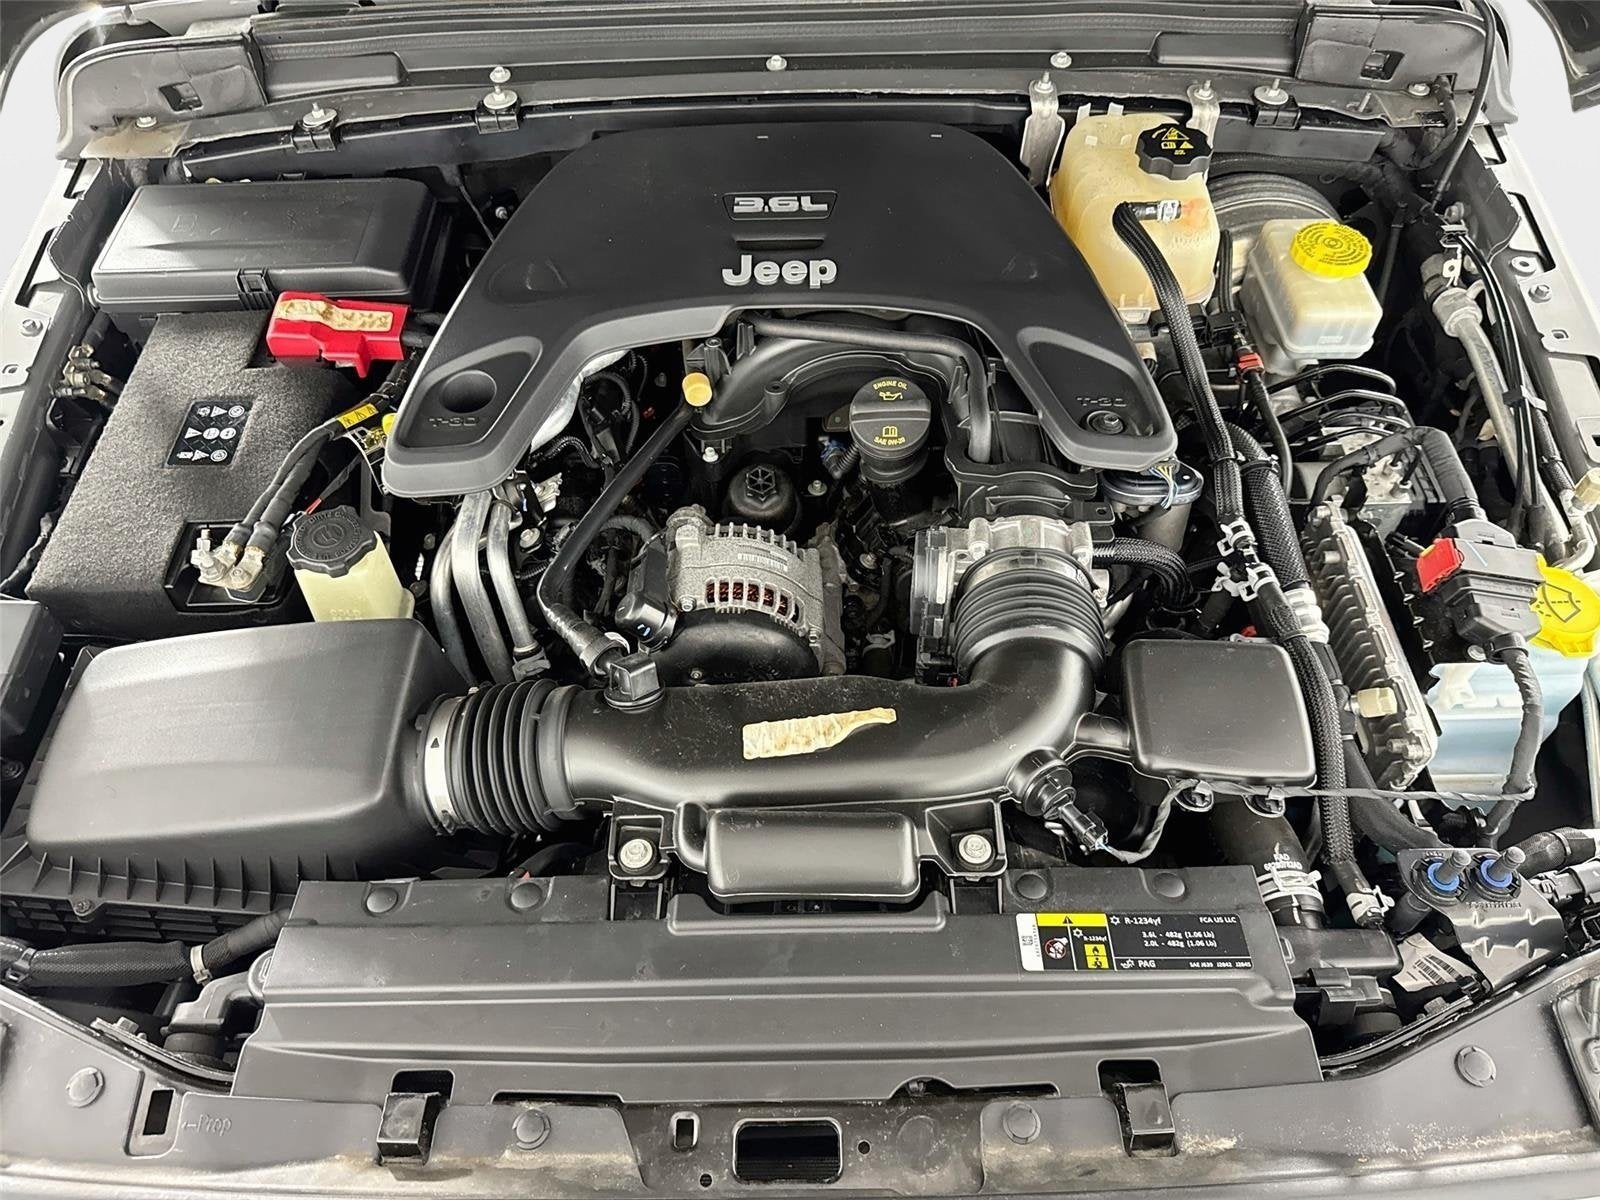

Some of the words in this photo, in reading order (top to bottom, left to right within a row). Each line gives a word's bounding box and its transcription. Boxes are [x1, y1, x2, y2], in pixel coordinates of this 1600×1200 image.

[733, 195, 828, 213] 3.6L
[721, 254, 838, 289] Jeep
[872, 380, 897, 390] ENGINE
[897, 382, 908, 390] OIL
[873, 436, 887, 446] SAE
[1124, 916, 1162, 927] R-1234yf
[1199, 916, 1214, 924] FCA
[1214, 916, 1225, 924] US
[1225, 916, 1237, 924] LLC
[1141, 931, 1158, 939] 3.6L
[1165, 931, 1183, 940] 482g
[1184, 931, 1203, 939] (1.06
[1144, 940, 1160, 948] 2.0L
[1167, 940, 1185, 949] 482g
[1186, 940, 1205, 948] (1.06
[1137, 960, 1156, 968] PAG
[197, 1114, 232, 1137] Prop
